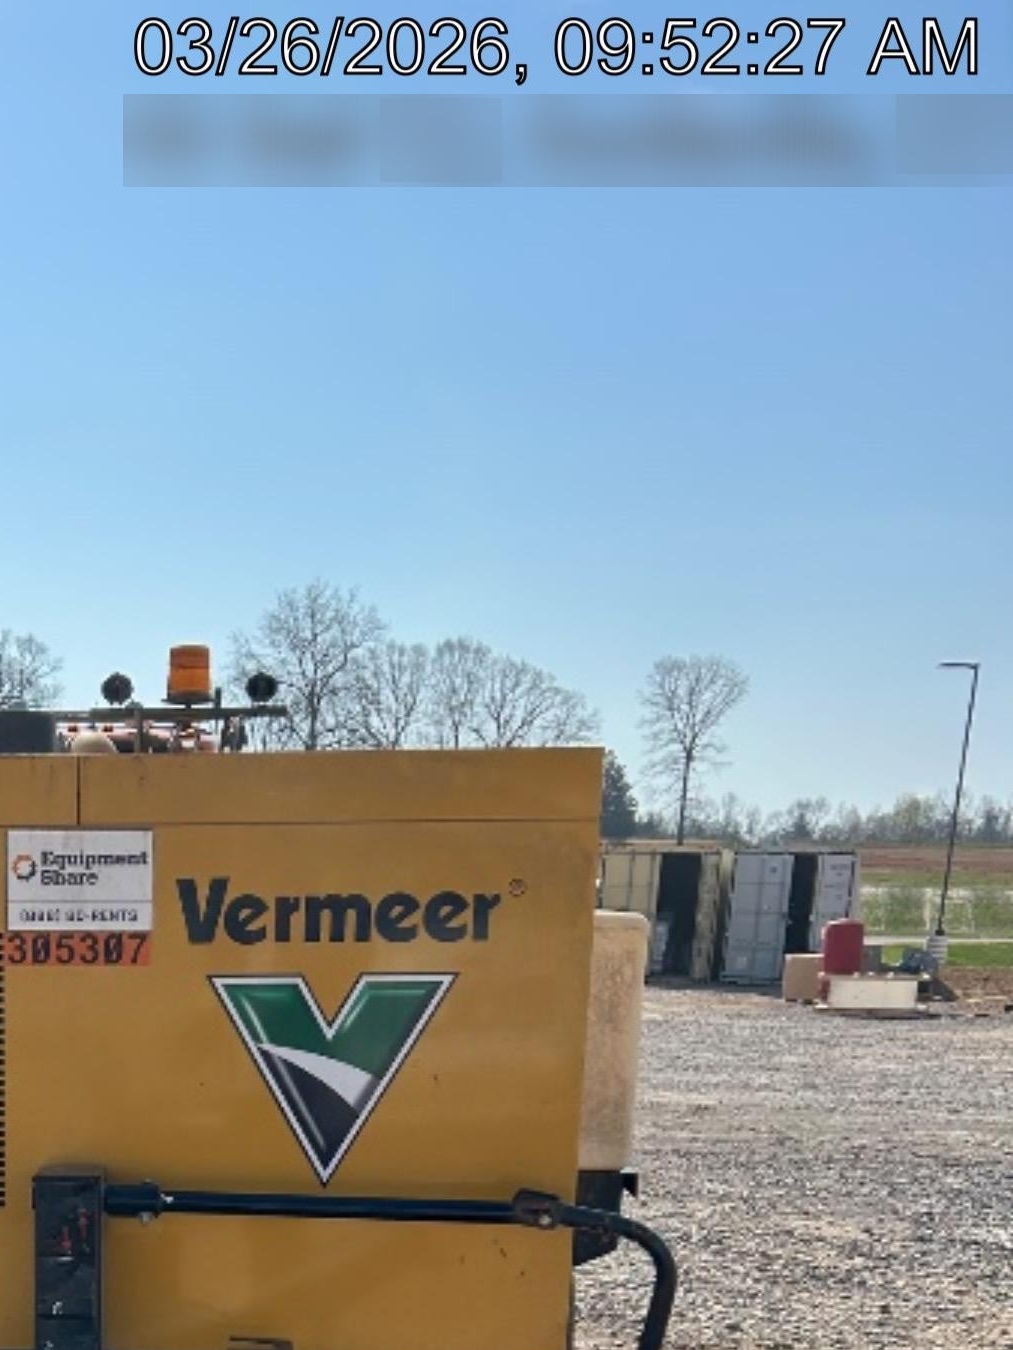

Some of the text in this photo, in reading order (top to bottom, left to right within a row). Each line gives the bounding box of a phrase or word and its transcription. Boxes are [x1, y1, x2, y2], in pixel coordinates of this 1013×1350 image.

[41, 851, 149, 870] Equipment
[41, 870, 99, 886] Share
[175, 876, 502, 945] Vermeer
[7, 932, 147, 965] 305307
